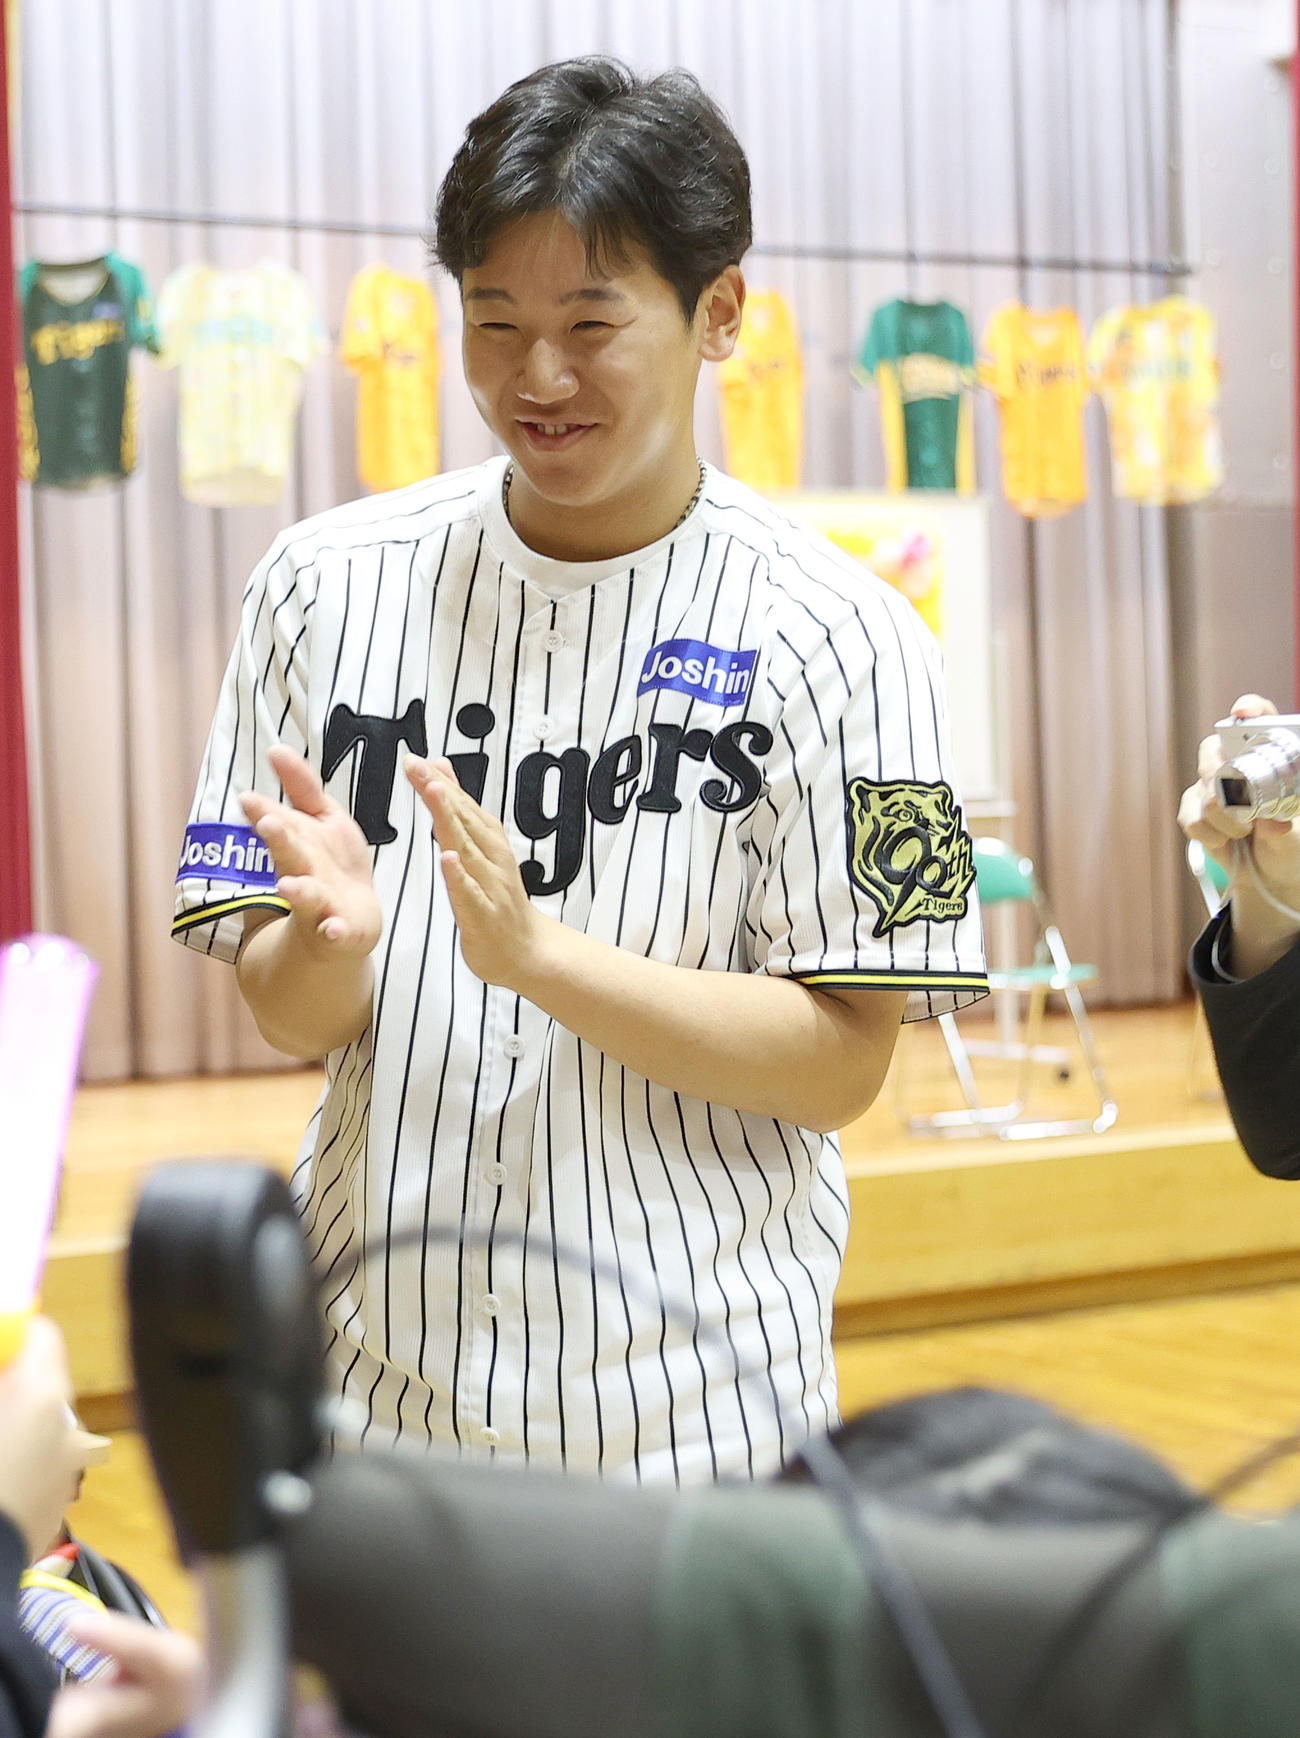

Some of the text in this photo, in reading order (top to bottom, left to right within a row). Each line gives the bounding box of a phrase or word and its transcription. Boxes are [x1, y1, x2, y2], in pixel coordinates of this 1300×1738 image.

[641, 650, 750, 695] Joshin
[179, 834, 276, 873] Joshin
[922, 897, 963, 914] Tigers
